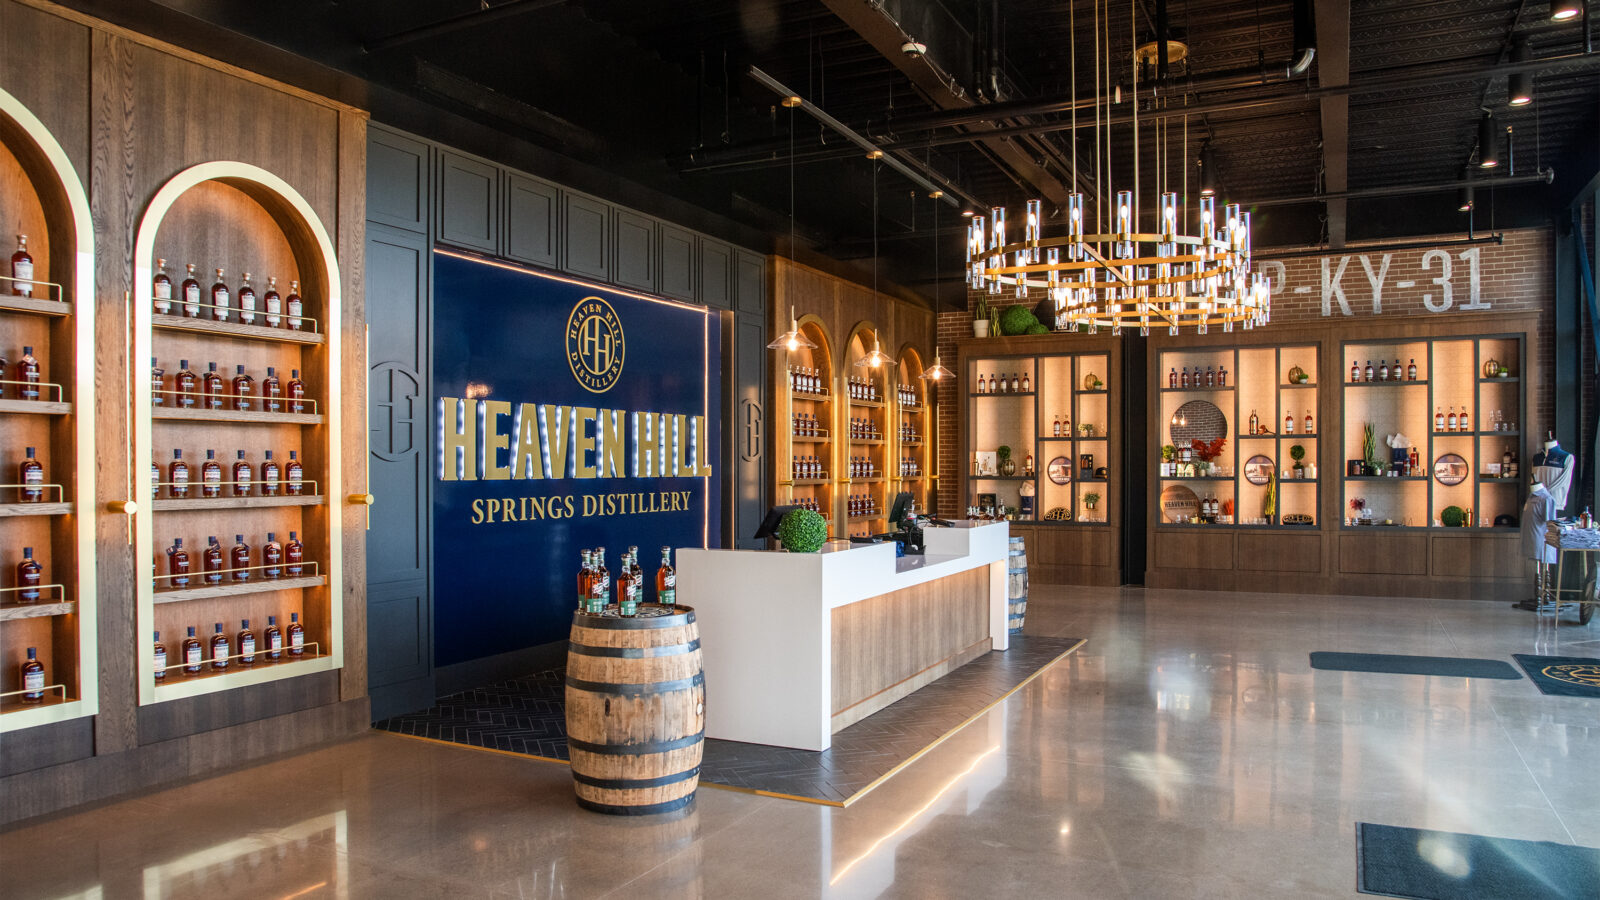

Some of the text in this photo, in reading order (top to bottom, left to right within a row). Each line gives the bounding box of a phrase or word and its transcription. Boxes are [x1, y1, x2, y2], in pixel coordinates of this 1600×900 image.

[570, 303, 621, 347] HEAVEN HILL
[571, 352, 620, 388] DISTILLERY
[438, 397, 712, 480] HEAVEN HILL
[472, 491, 691, 524] SPRINGS DISTILLERY
